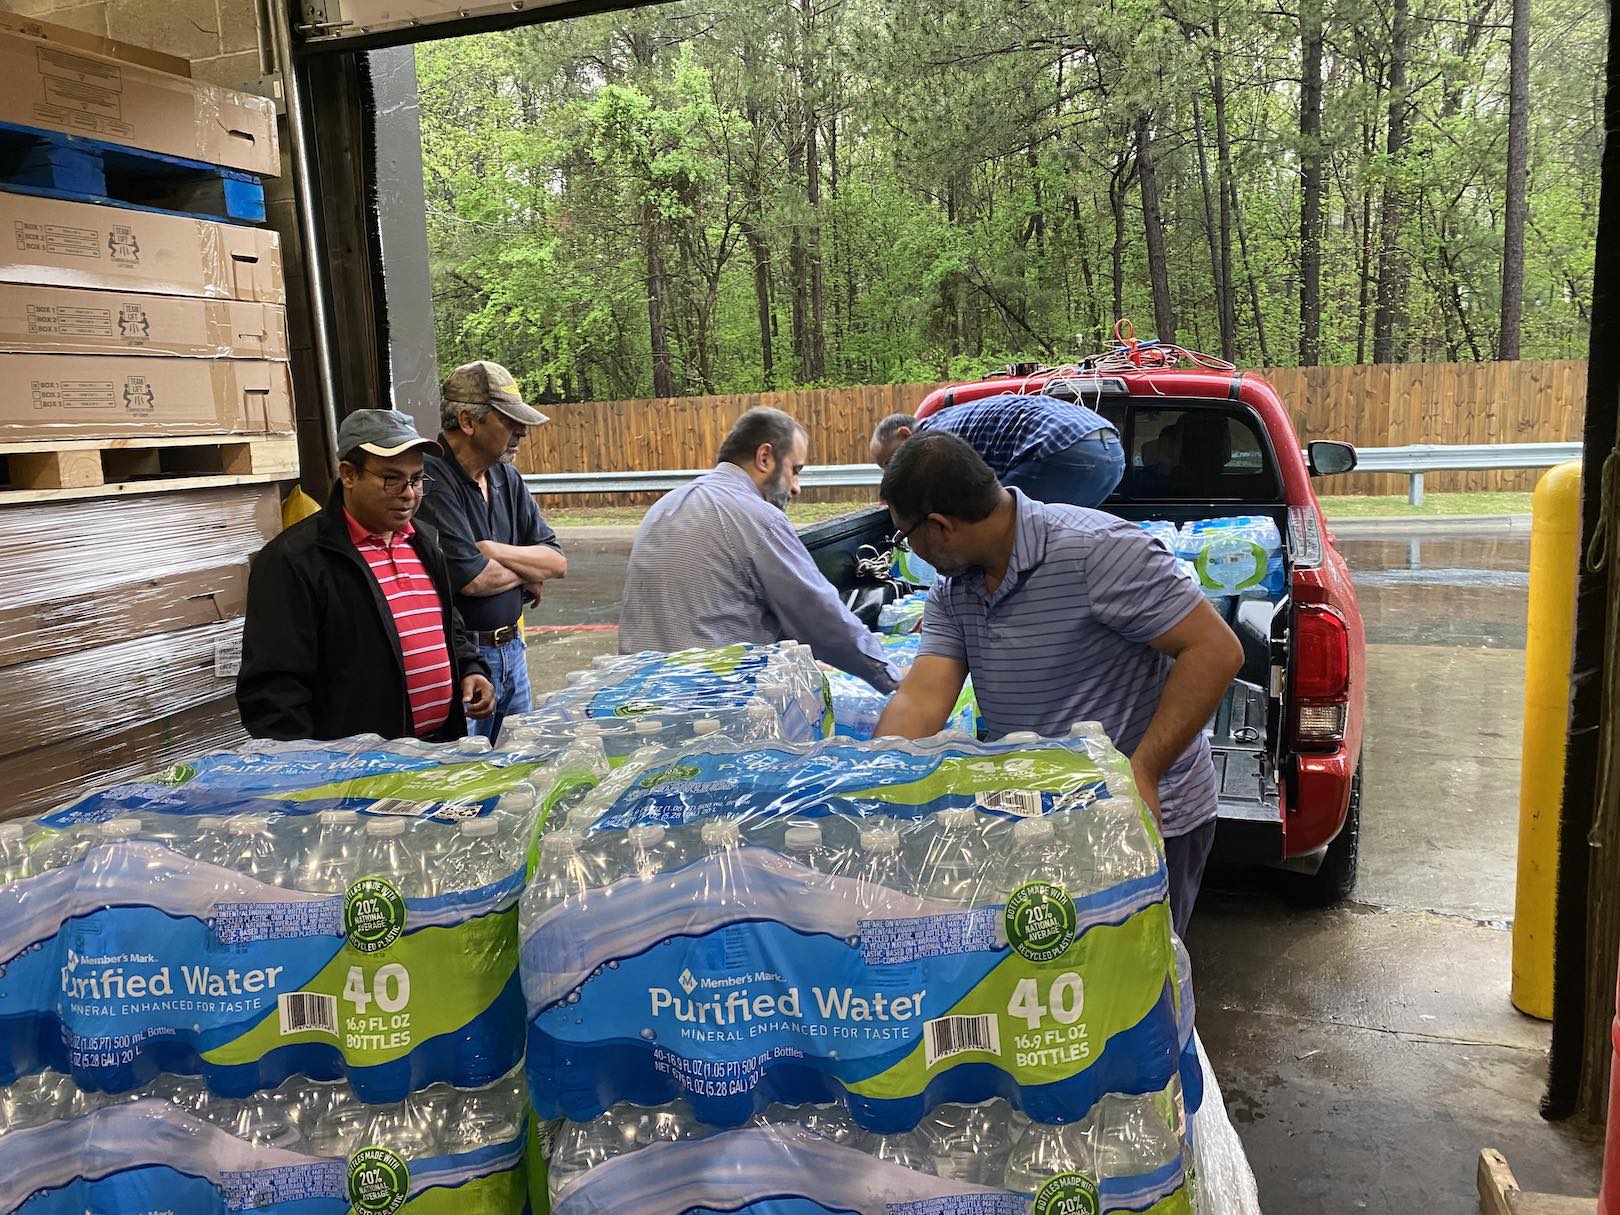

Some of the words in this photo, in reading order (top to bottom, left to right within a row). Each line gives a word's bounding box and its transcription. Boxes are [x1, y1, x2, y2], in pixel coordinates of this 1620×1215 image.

[362, 882, 382, 893] MDE
[381, 886, 397, 901] WITH
[356, 898, 379, 916] 20%
[1007, 890, 1028, 920] BOTTLES
[1027, 885, 1050, 895] MADE
[1050, 888, 1068, 905] WITH
[354, 912, 386, 924] NATIONAL
[1025, 903, 1052, 924] 20%
[1025, 917, 1059, 933] NATIONAL
[1028, 926, 1060, 942] AVERAGE
[378, 925, 400, 948] PLASTIC
[1017, 943, 1052, 960] RECYCLED
[1052, 930, 1073, 956] PLASTIC
[81, 953, 128, 965] Member's
[181, 966, 284, 996] Water
[343, 963, 410, 1014] 40
[701, 974, 753, 988] Member's
[70, 1002, 116, 1016] MNERAL
[122, 1000, 193, 1015] ENHANCED
[197, 1002, 215, 1012] FOR
[219, 998, 262, 1012] TASTE
[649, 987, 802, 1025] Purified
[812, 987, 927, 1022] Water
[1008, 972, 1084, 1030] 40
[346, 1017, 366, 1033] 16.9
[369, 1017, 388, 1031] FL
[391, 1014, 410, 1029] OZ
[682, 1028, 743, 1042] MINERAL
[750, 1021, 828, 1038] ENHANCED
[834, 1027, 858, 1038] FOR
[864, 1027, 910, 1039] TASTE
[81, 1037, 97, 1052] (1.05
[99, 1037, 111, 1052] PT)
[114, 1035, 130, 1049] 500
[132, 1031, 146, 1044] mL
[346, 1031, 410, 1050] BOTTLES
[1014, 1034, 1041, 1049] 16.9
[1045, 1030, 1065, 1044] FL
[1068, 1024, 1088, 1039] OZ
[82, 1053, 100, 1068] (5.28
[101, 1052, 119, 1067] GAL)
[122, 1050, 133, 1063] 20
[135, 1046, 142, 1056] L
[683, 1059, 691, 1073] FL
[693, 1060, 702, 1076] OZ
[704, 1062, 724, 1080] (1.05
[727, 1061, 740, 1079] PT)
[742, 1057, 756, 1075] 500
[759, 1050, 772, 1065] mL
[774, 1047, 804, 1058] Bottles
[1016, 1042, 1089, 1067] BOTTLES
[655, 1061, 670, 1073] NET
[686, 1076, 694, 1092] FL
[694, 1079, 704, 1094] OZ
[706, 1080, 727, 1098] (5.28
[729, 1079, 748, 1095] GAL)
[749, 1071, 758, 1090] 20
[760, 1066, 766, 1077] L
[365, 1151, 384, 1160] MADE
[383, 1154, 400, 1170] WITH
[360, 1168, 382, 1186] 20%
[359, 1182, 390, 1194] NATIONAL
[363, 1190, 389, 1201] AVERAGE
[1037, 1181, 1060, 1210] BOTTLES
[1060, 1176, 1080, 1187] MADE
[1057, 1195, 1083, 1215] 20%
